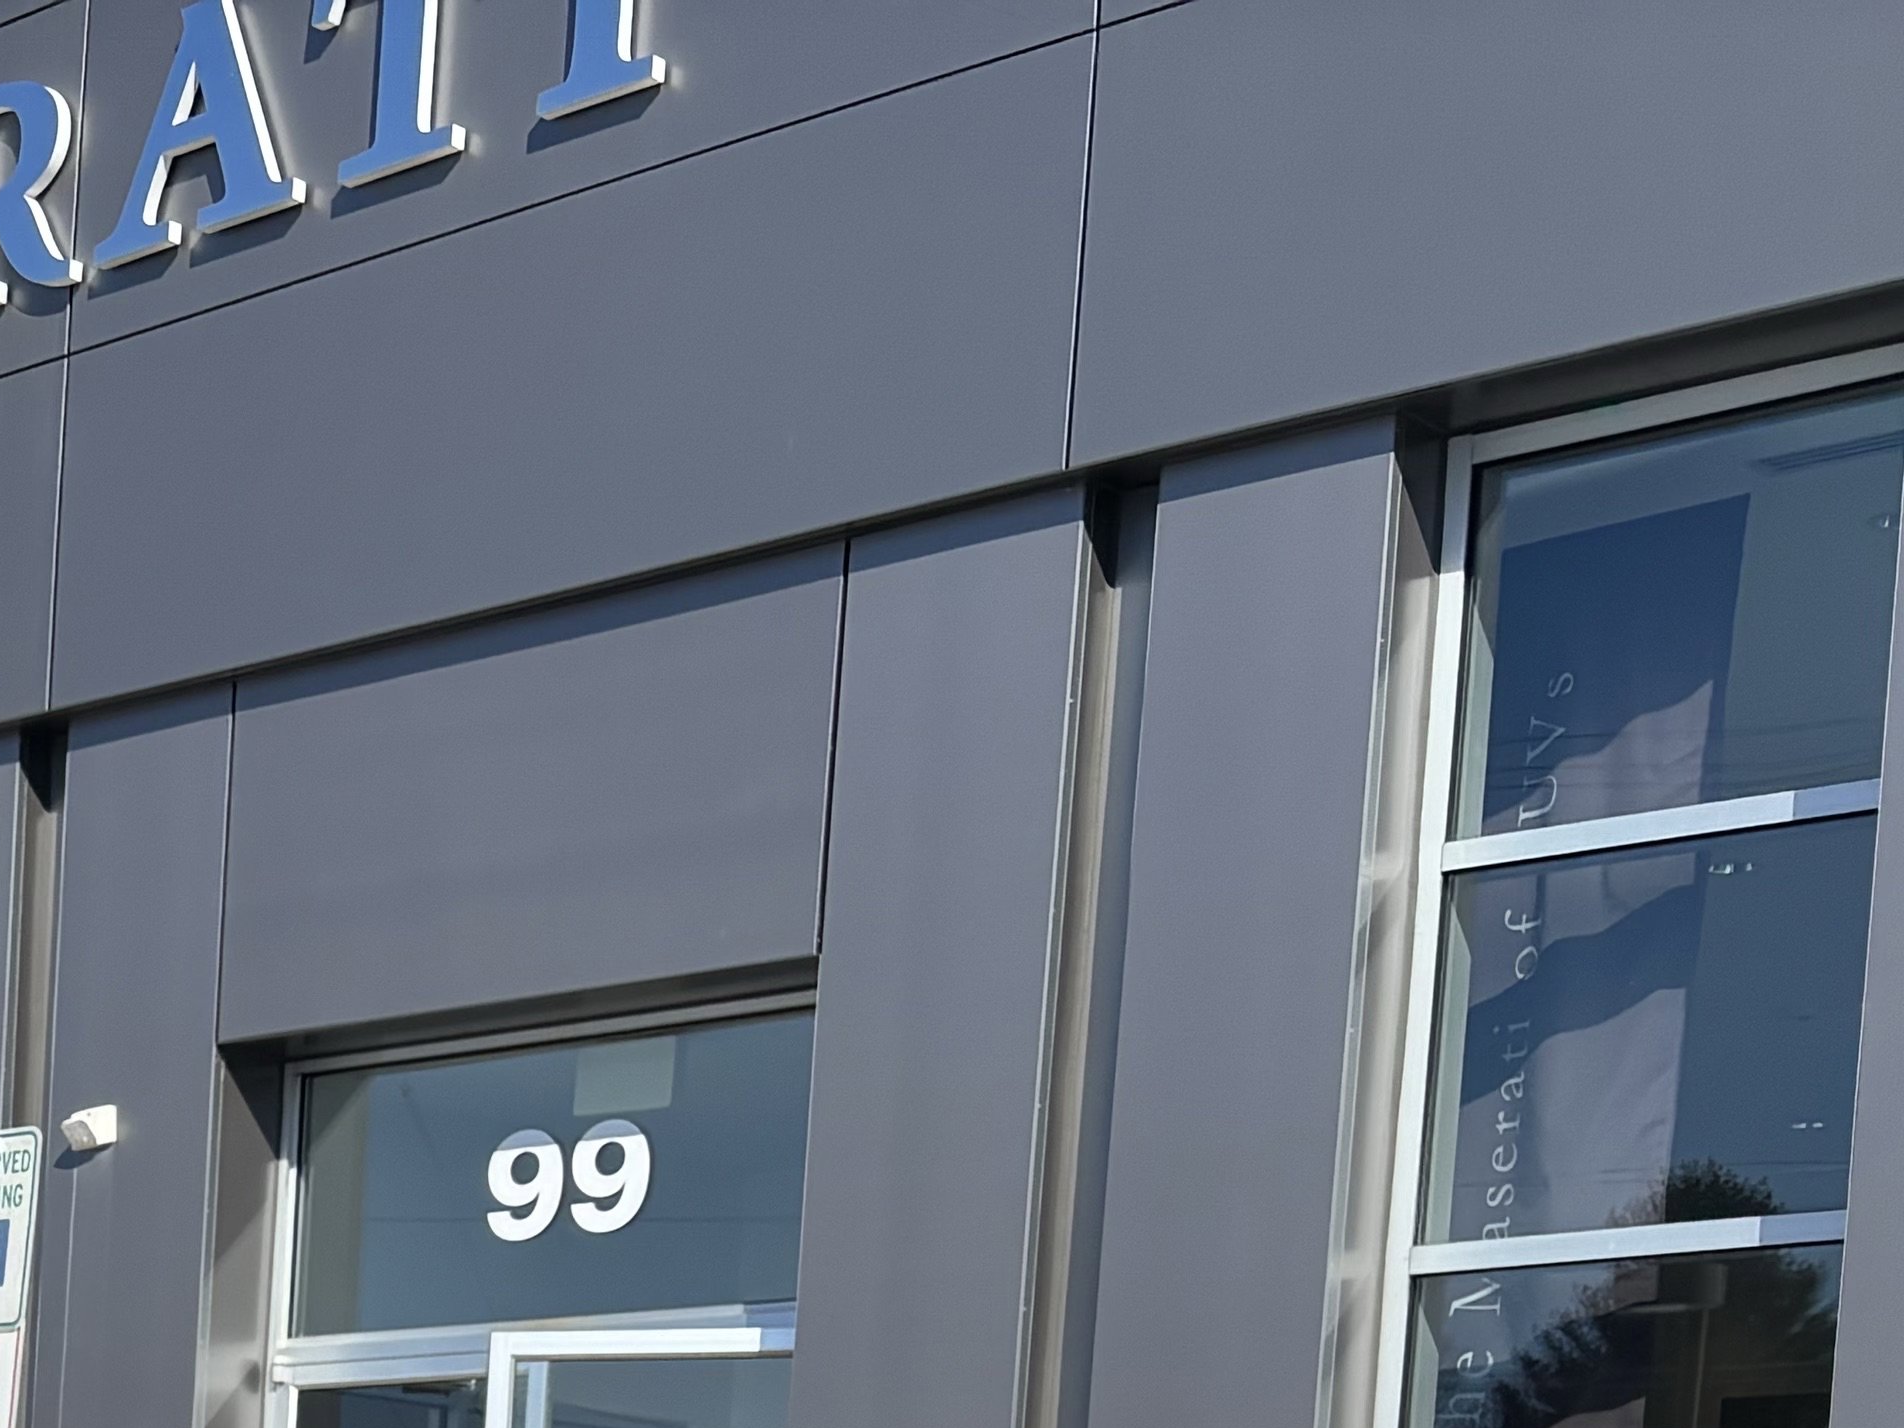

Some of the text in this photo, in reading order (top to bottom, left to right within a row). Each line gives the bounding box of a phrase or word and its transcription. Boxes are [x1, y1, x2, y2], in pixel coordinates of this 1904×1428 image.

[1517, 672, 1575, 828] UVs
[1504, 908, 1541, 981] of
[487, 1118, 651, 1242] 99
